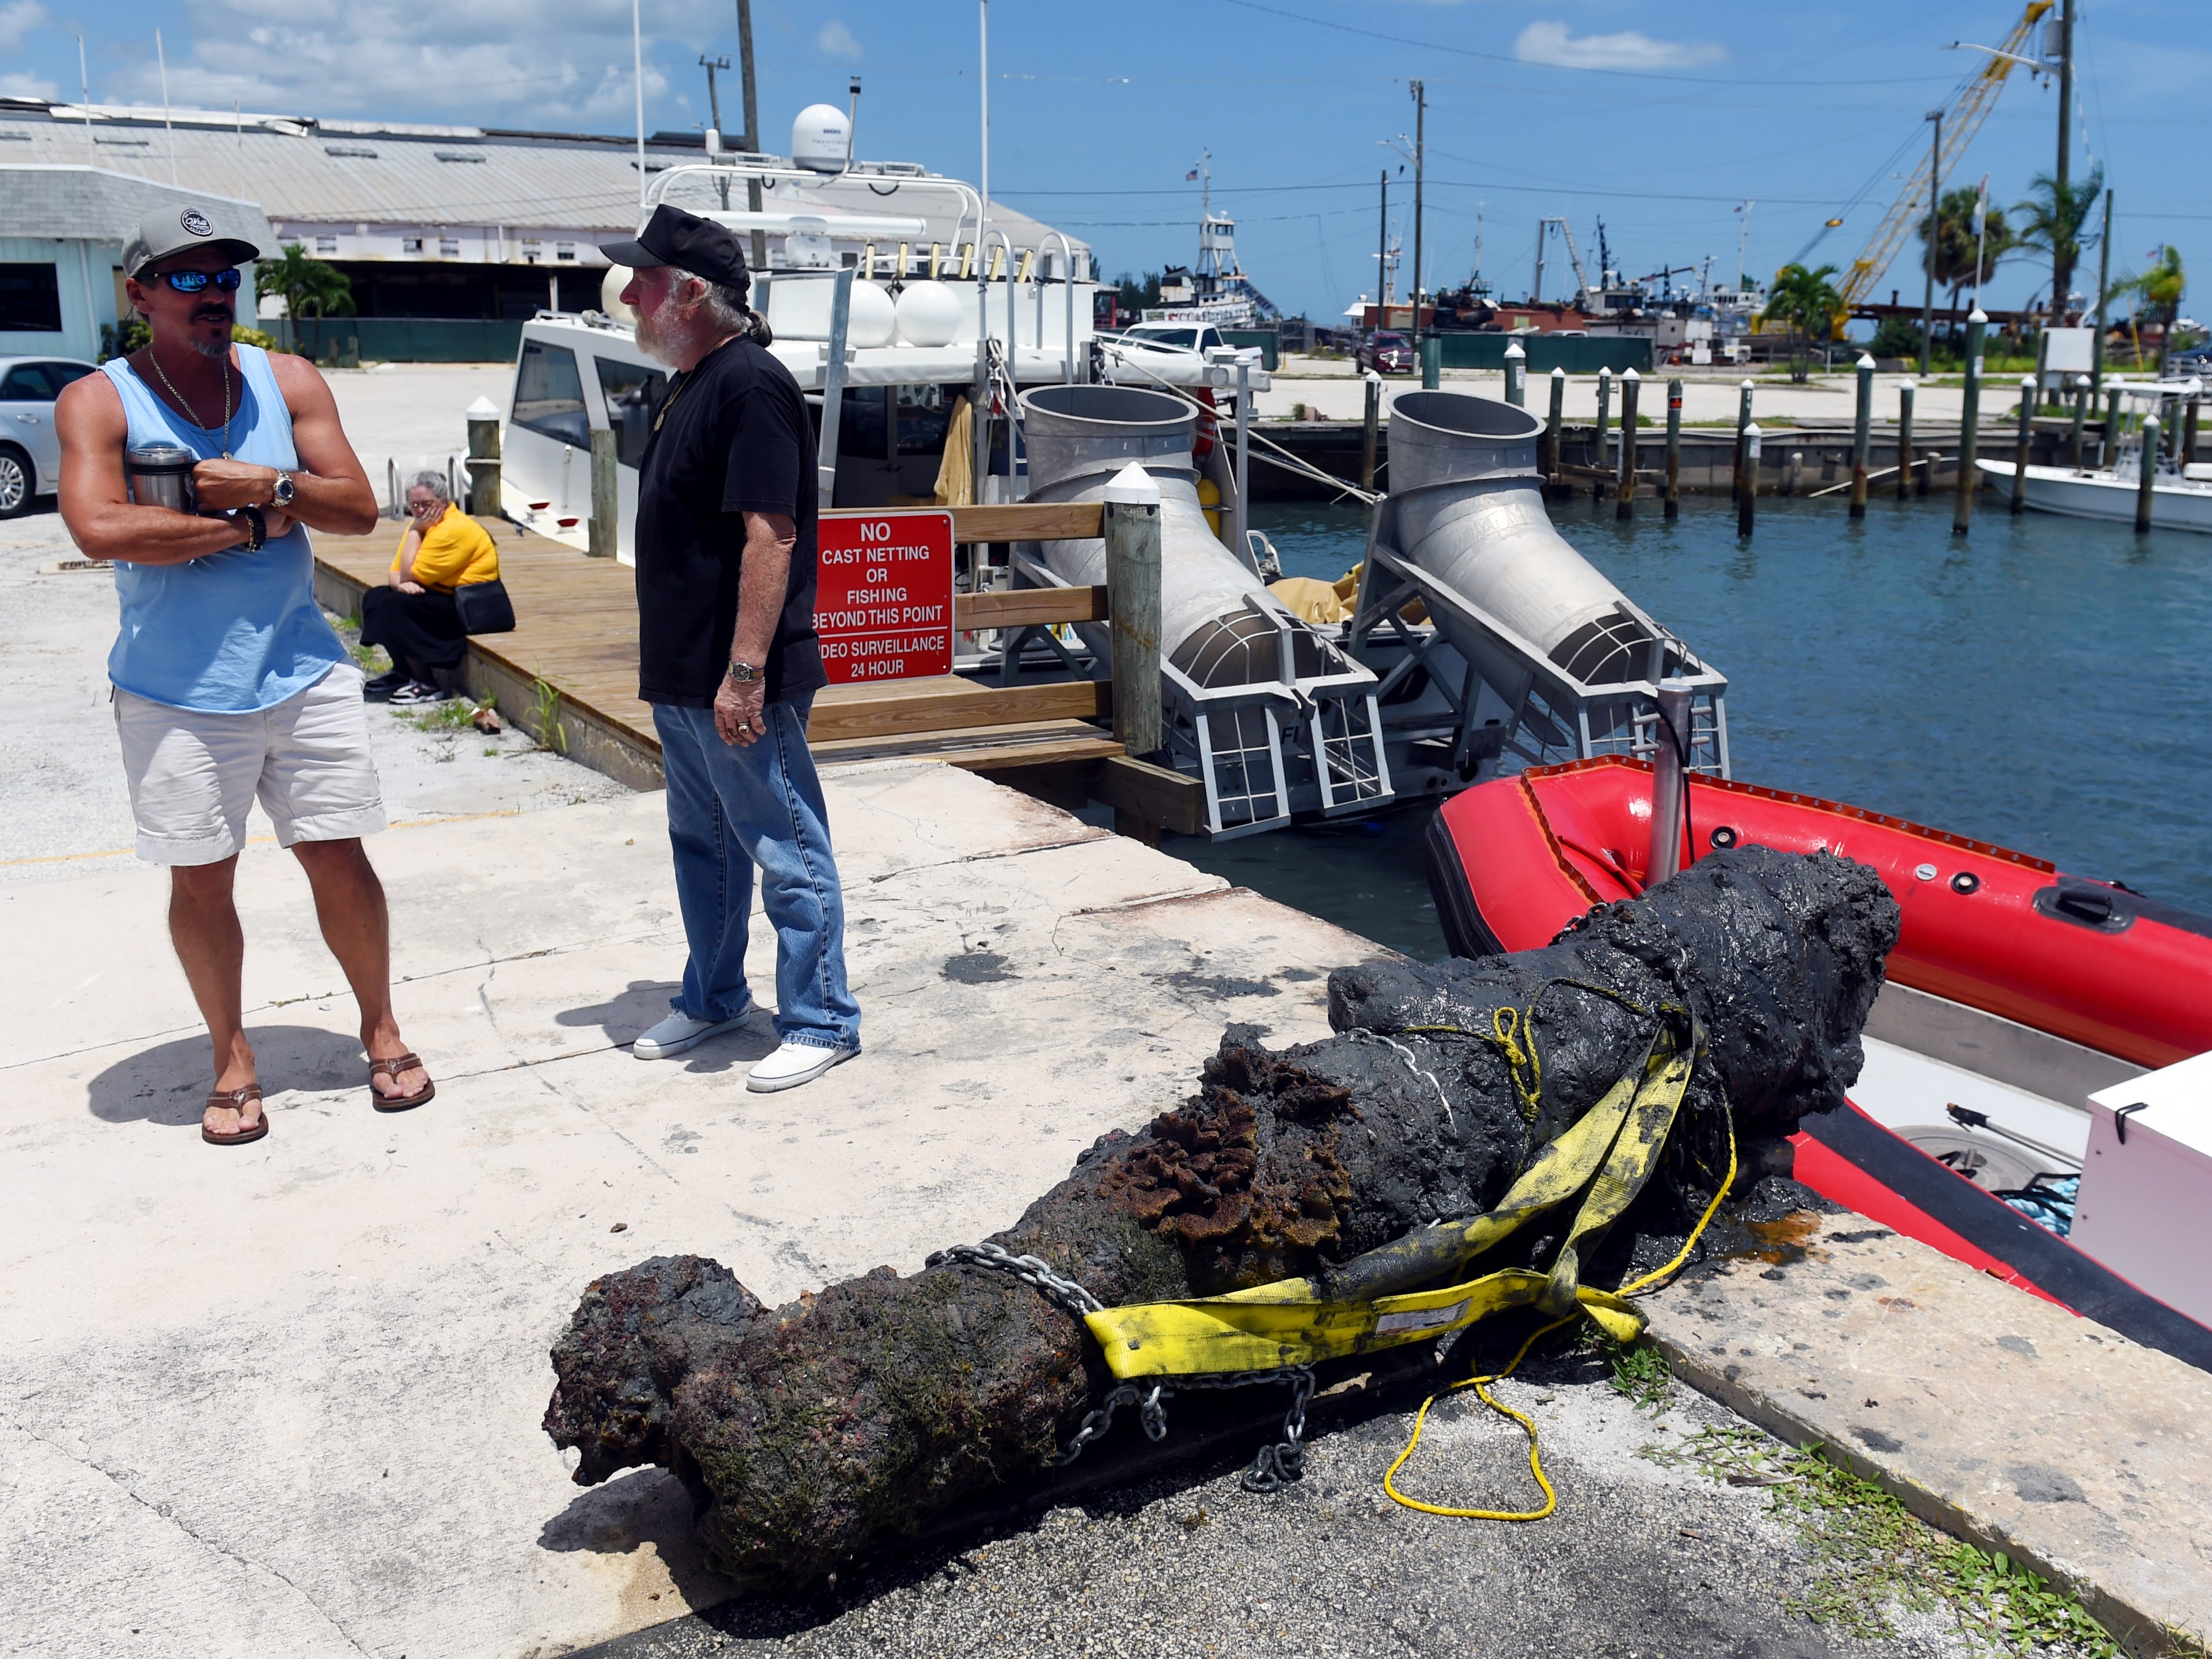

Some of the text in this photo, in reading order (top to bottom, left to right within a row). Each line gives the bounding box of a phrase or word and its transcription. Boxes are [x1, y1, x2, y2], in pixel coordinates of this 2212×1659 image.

[861, 522, 891, 542] NO
[822, 545, 929, 565] CAST NETTING
[866, 568, 888, 583] OR
[847, 587, 907, 605] FISHING
[812, 605, 943, 629] BEYOND THIS POINT
[818, 635, 944, 659] DEO SURVEILLANCE
[851, 659, 904, 677] 24 HOUR
